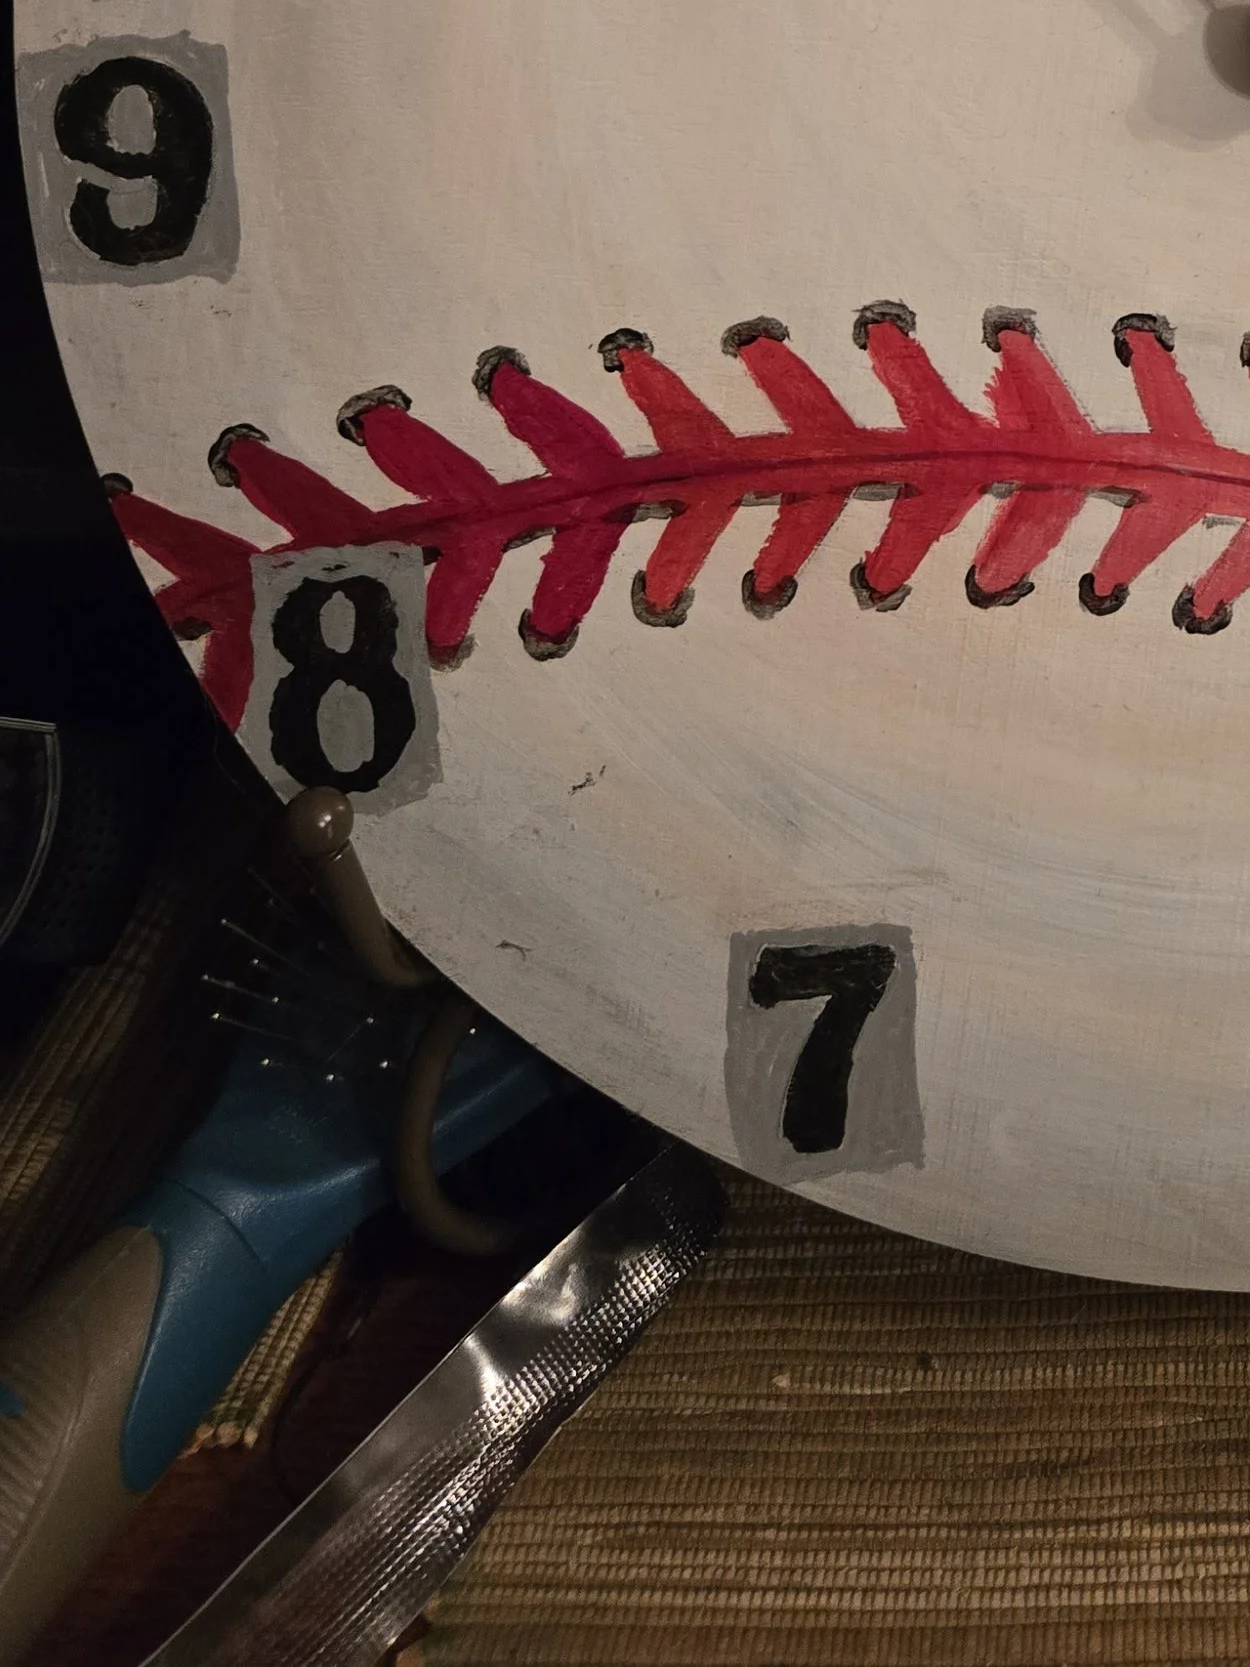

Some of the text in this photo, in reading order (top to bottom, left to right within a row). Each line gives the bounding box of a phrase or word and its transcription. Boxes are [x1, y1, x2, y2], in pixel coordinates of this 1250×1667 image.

[54, 56, 214, 264] 9
[270, 575, 415, 793] 8
[750, 944, 897, 1152] 7
